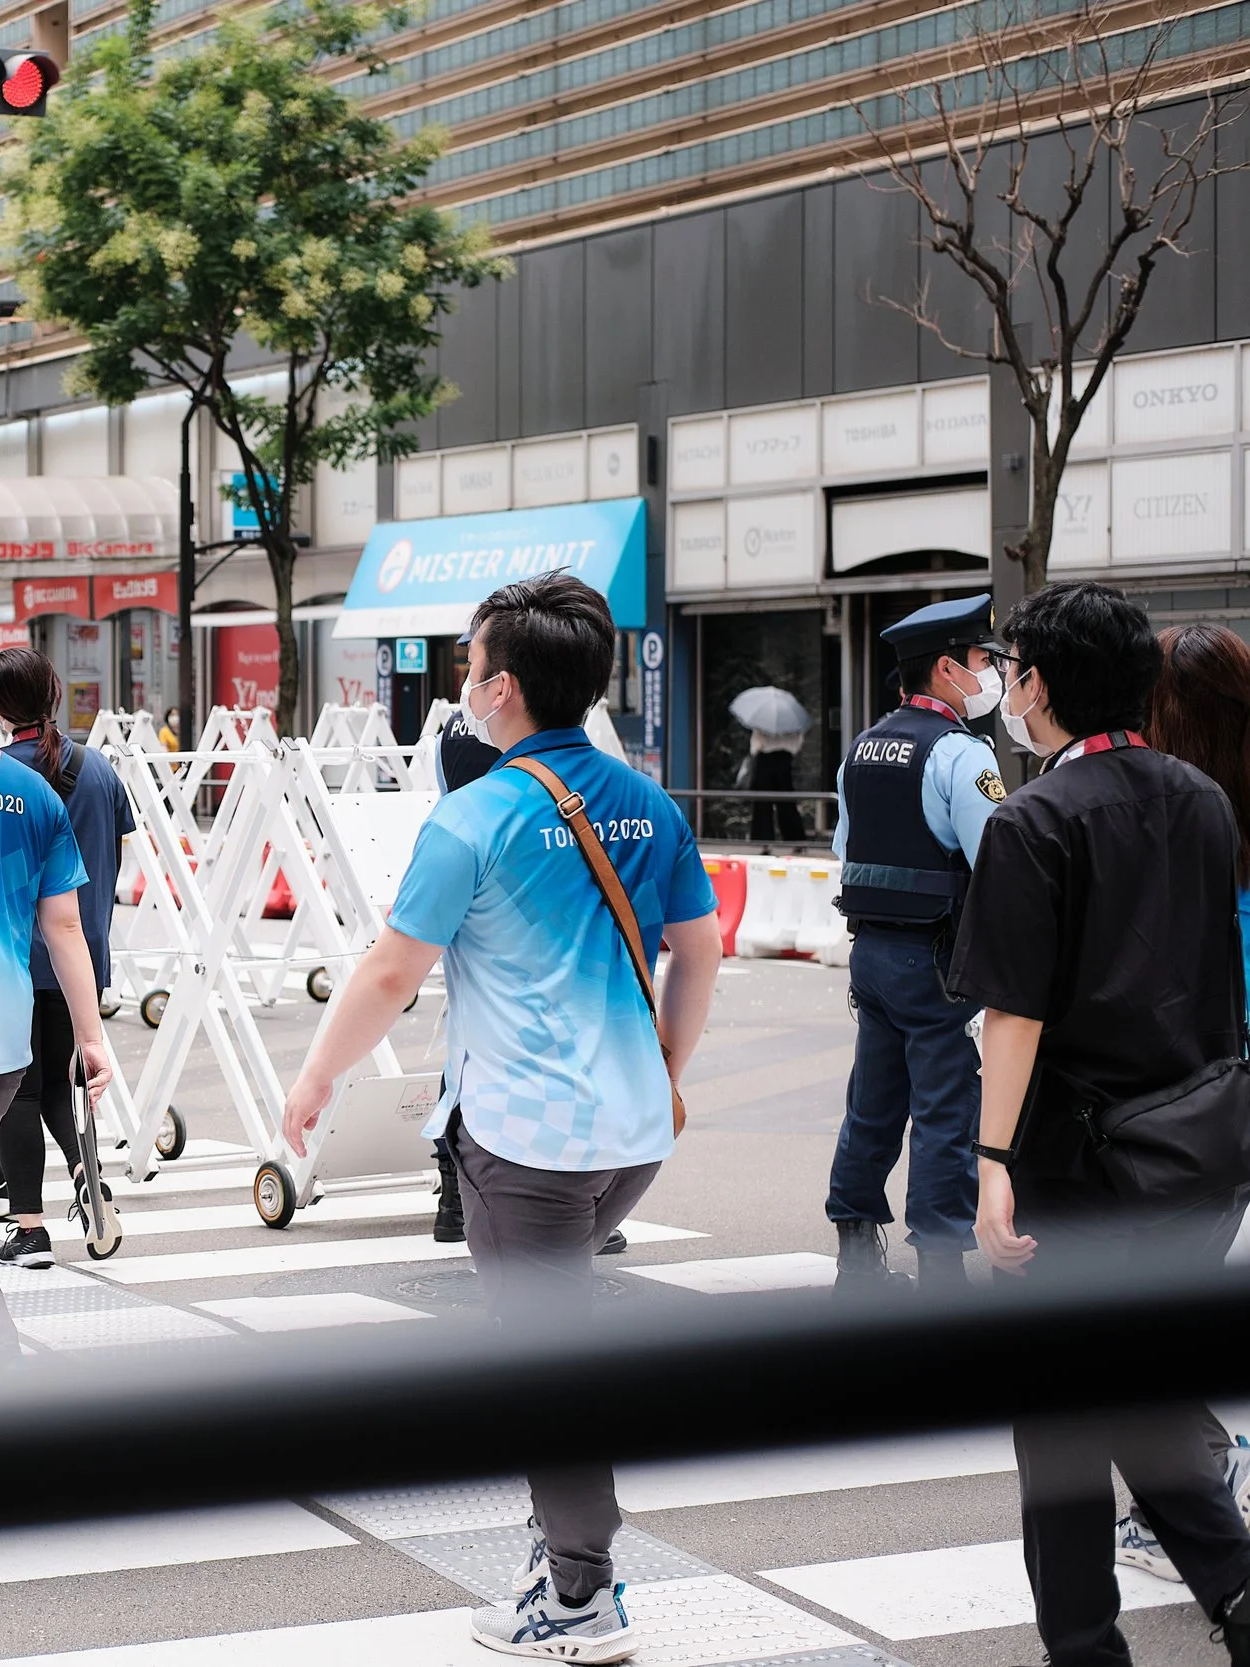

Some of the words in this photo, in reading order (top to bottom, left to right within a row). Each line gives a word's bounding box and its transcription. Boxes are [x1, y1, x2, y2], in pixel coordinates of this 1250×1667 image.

[1132, 383, 1219, 409] ONKYO
[1133, 492, 1209, 520] CITIZEN
[407, 549, 506, 584] MISTER
[505, 540, 597, 577] MINIT
[450, 720, 476, 738] POL
[854, 740, 914, 764] POLICE
[539, 822, 605, 850] TOKO
[608, 819, 654, 842] 2020
